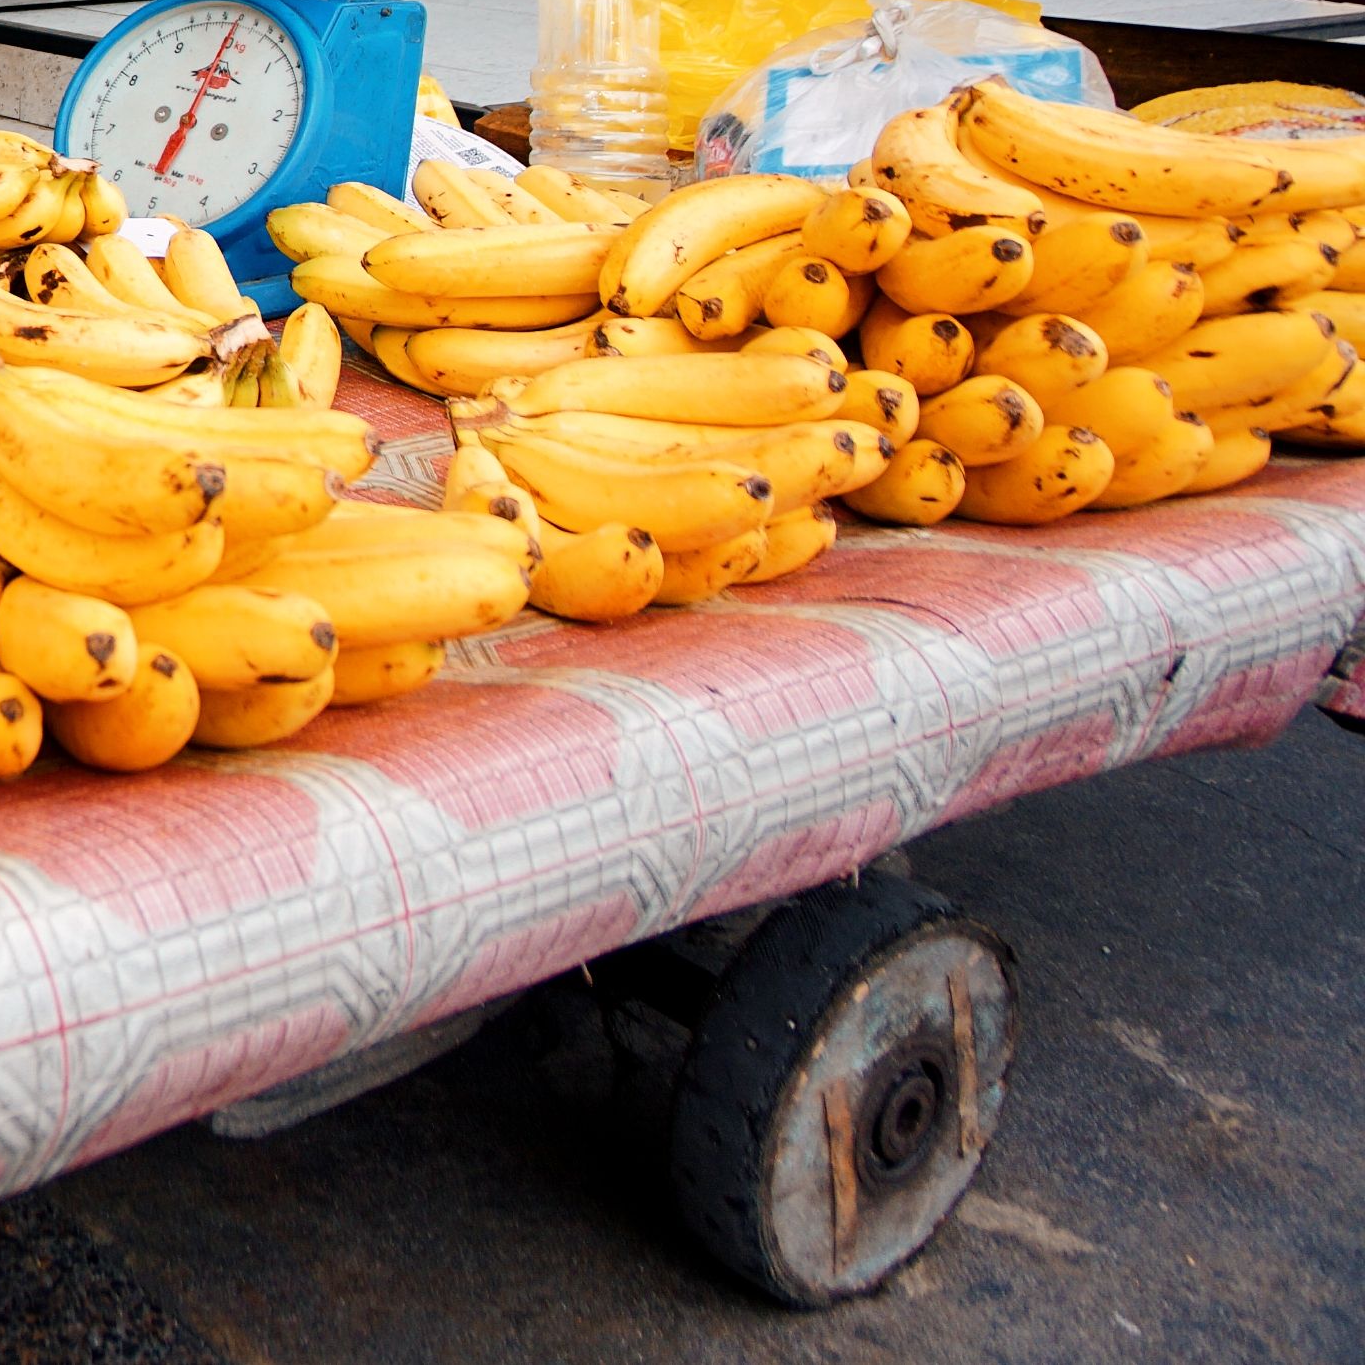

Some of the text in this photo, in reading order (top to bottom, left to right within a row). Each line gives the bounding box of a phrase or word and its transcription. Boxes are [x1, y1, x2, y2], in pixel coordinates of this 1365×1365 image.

[173, 41, 185, 55] 9
[233, 40, 247, 54] kg
[128, 74, 139, 87] 8
[272, 108, 284, 123] 2
[105, 122, 117, 136] 7
[247, 161, 259, 176] 3
[112, 169, 124, 183] 6
[147, 195, 159, 210] 5
[198, 194, 210, 208] 4
